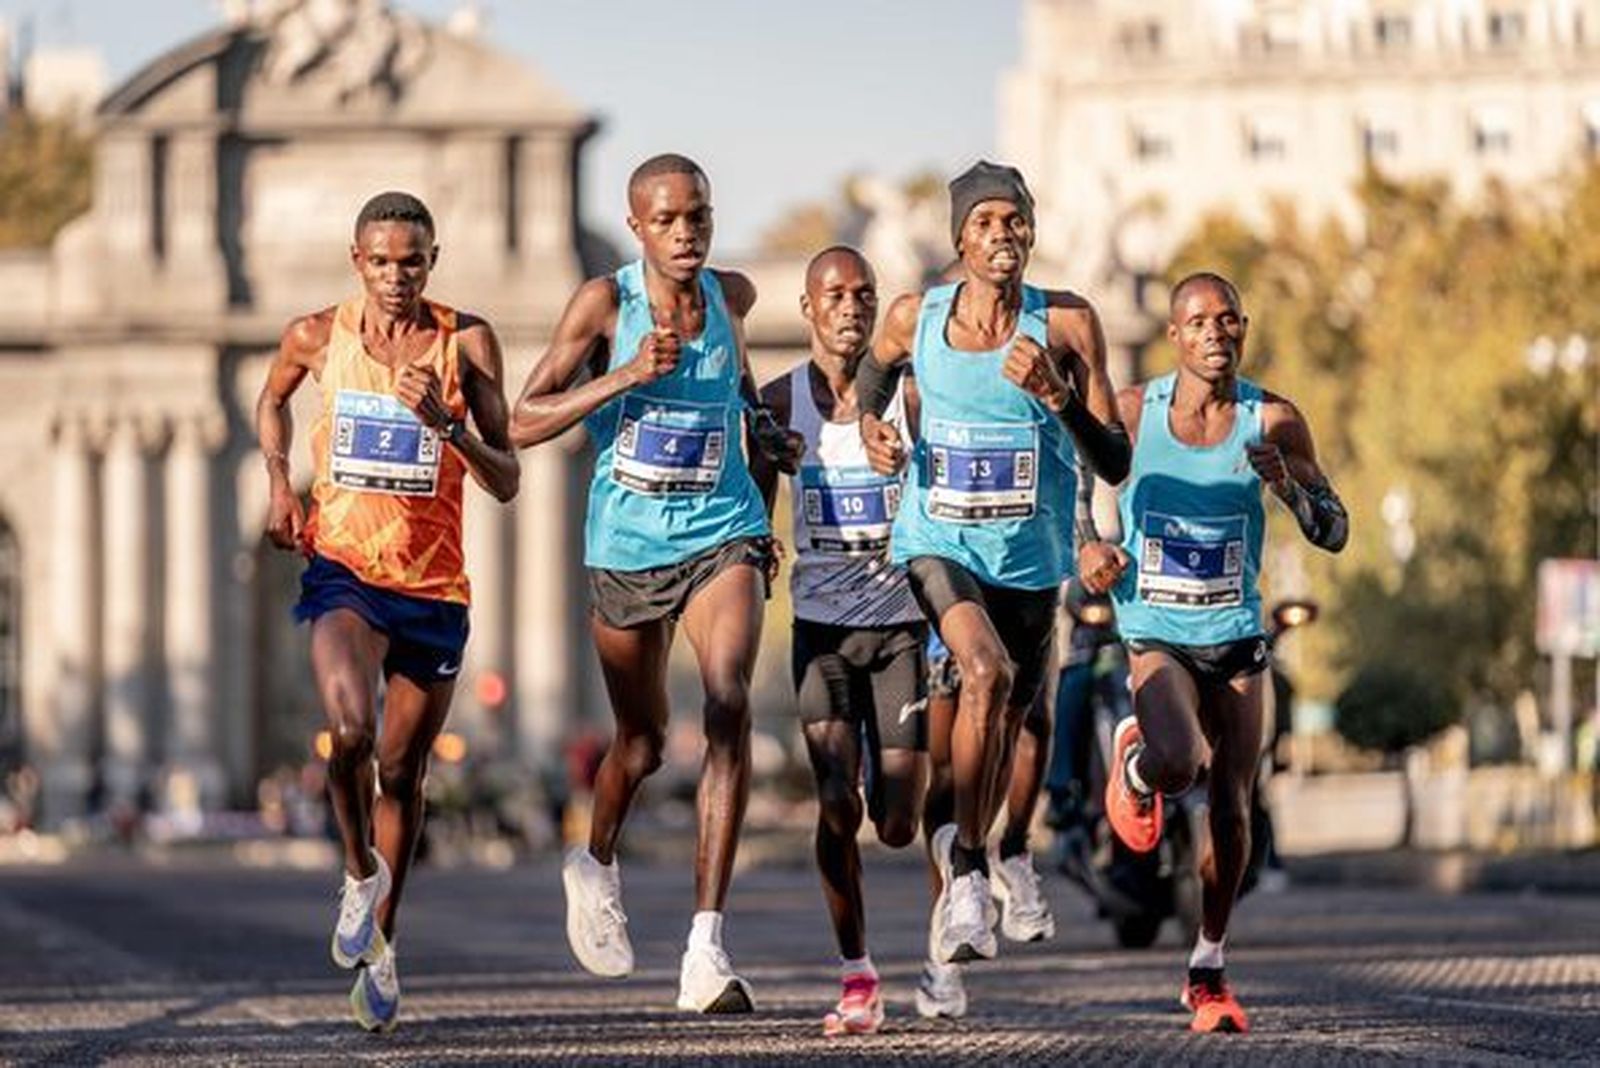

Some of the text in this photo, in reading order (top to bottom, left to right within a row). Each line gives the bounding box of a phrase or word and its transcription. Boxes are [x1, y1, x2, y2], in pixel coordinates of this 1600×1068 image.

[379, 430, 392, 449] 2
[664, 437, 677, 455] 4
[968, 459, 992, 478] 13
[841, 496, 864, 514] 10
